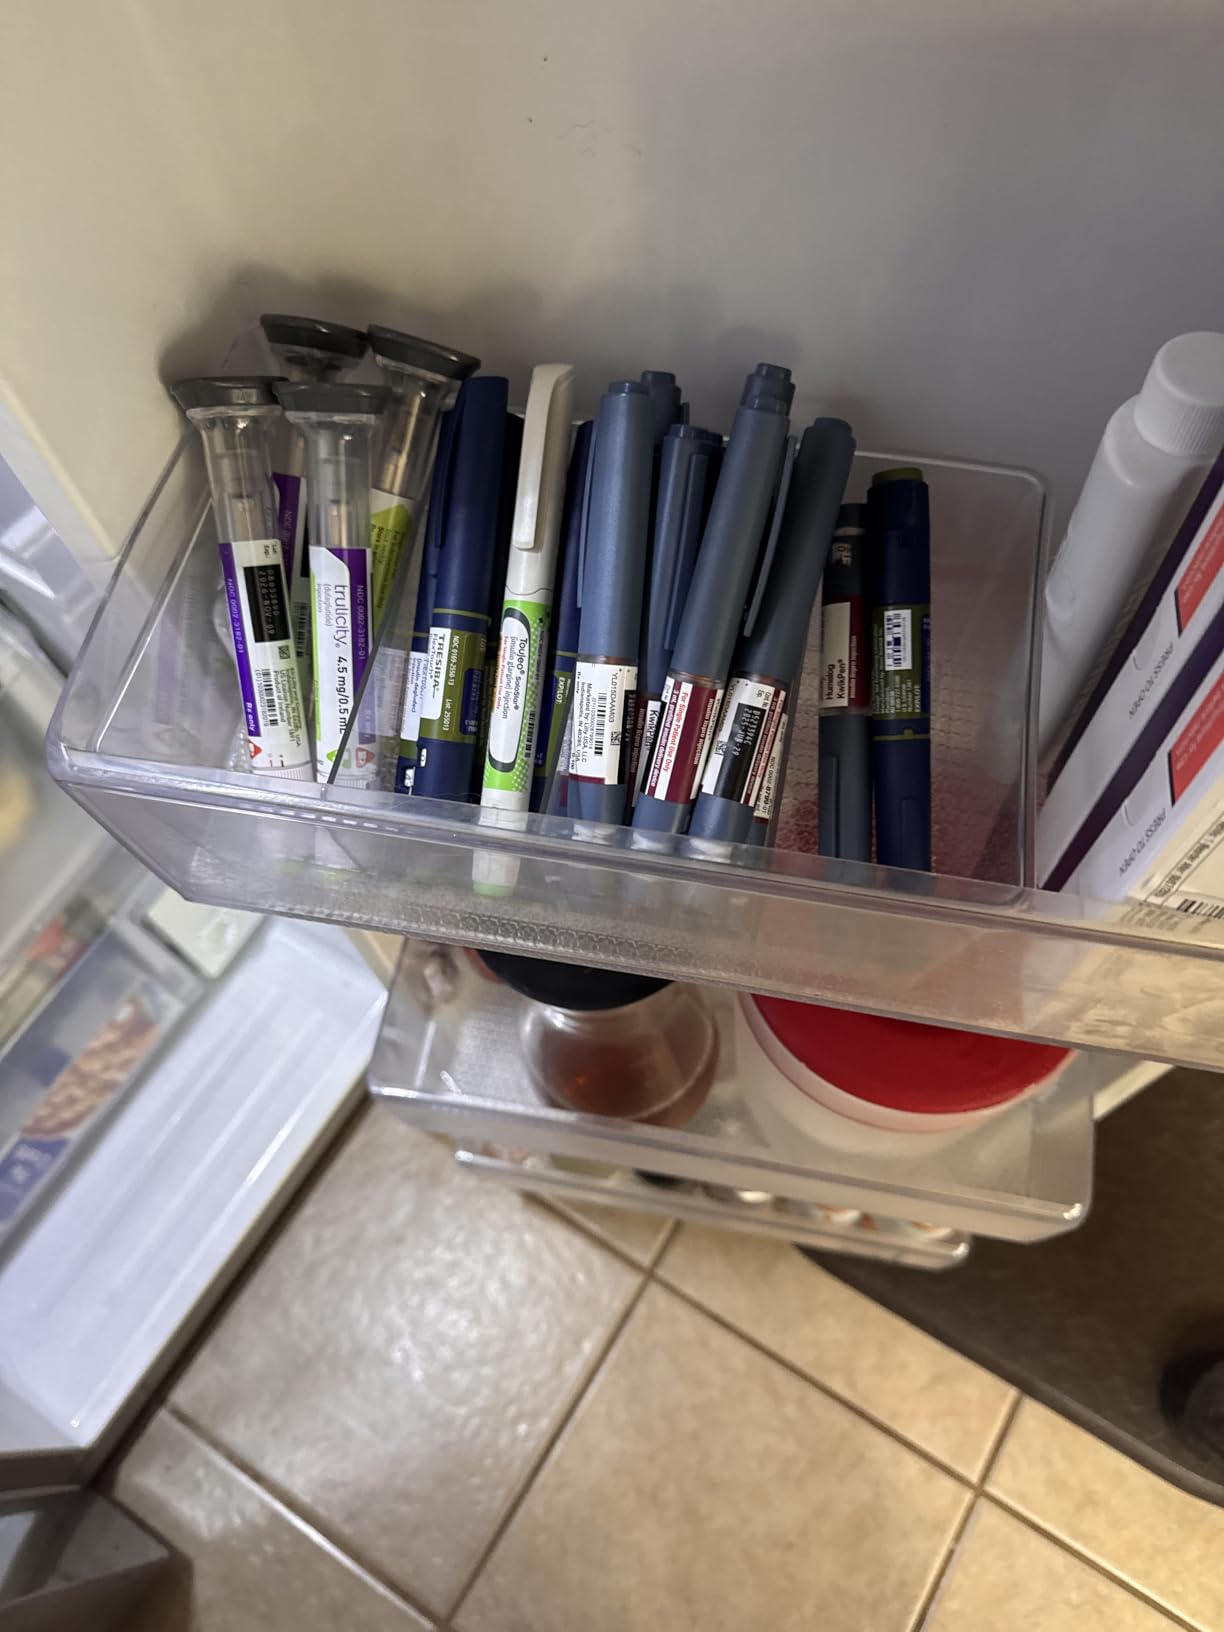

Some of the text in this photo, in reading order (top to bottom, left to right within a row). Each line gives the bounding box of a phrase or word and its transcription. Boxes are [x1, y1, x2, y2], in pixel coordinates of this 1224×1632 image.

[324, 583, 332, 627] (dulaglutide)
[338, 656, 346, 673] 4.5
[503, 636, 517, 719] (insulin glargine) injection
[826, 664, 835, 700] Humalog
[338, 676, 349, 715] mg/0.5
[671, 694, 678, 704] mL
[247, 702, 257, 732] Rx only
[665, 704, 676, 728] prefilled
[675, 703, 686, 724] Single
[661, 727, 670, 746] insulin
[670, 724, 680, 746] Patient
[692, 698, 715, 765] insulin lispro injection
[655, 746, 665, 769] delivery
[663, 758, 672, 773] Only
[651, 768, 660, 787] device
